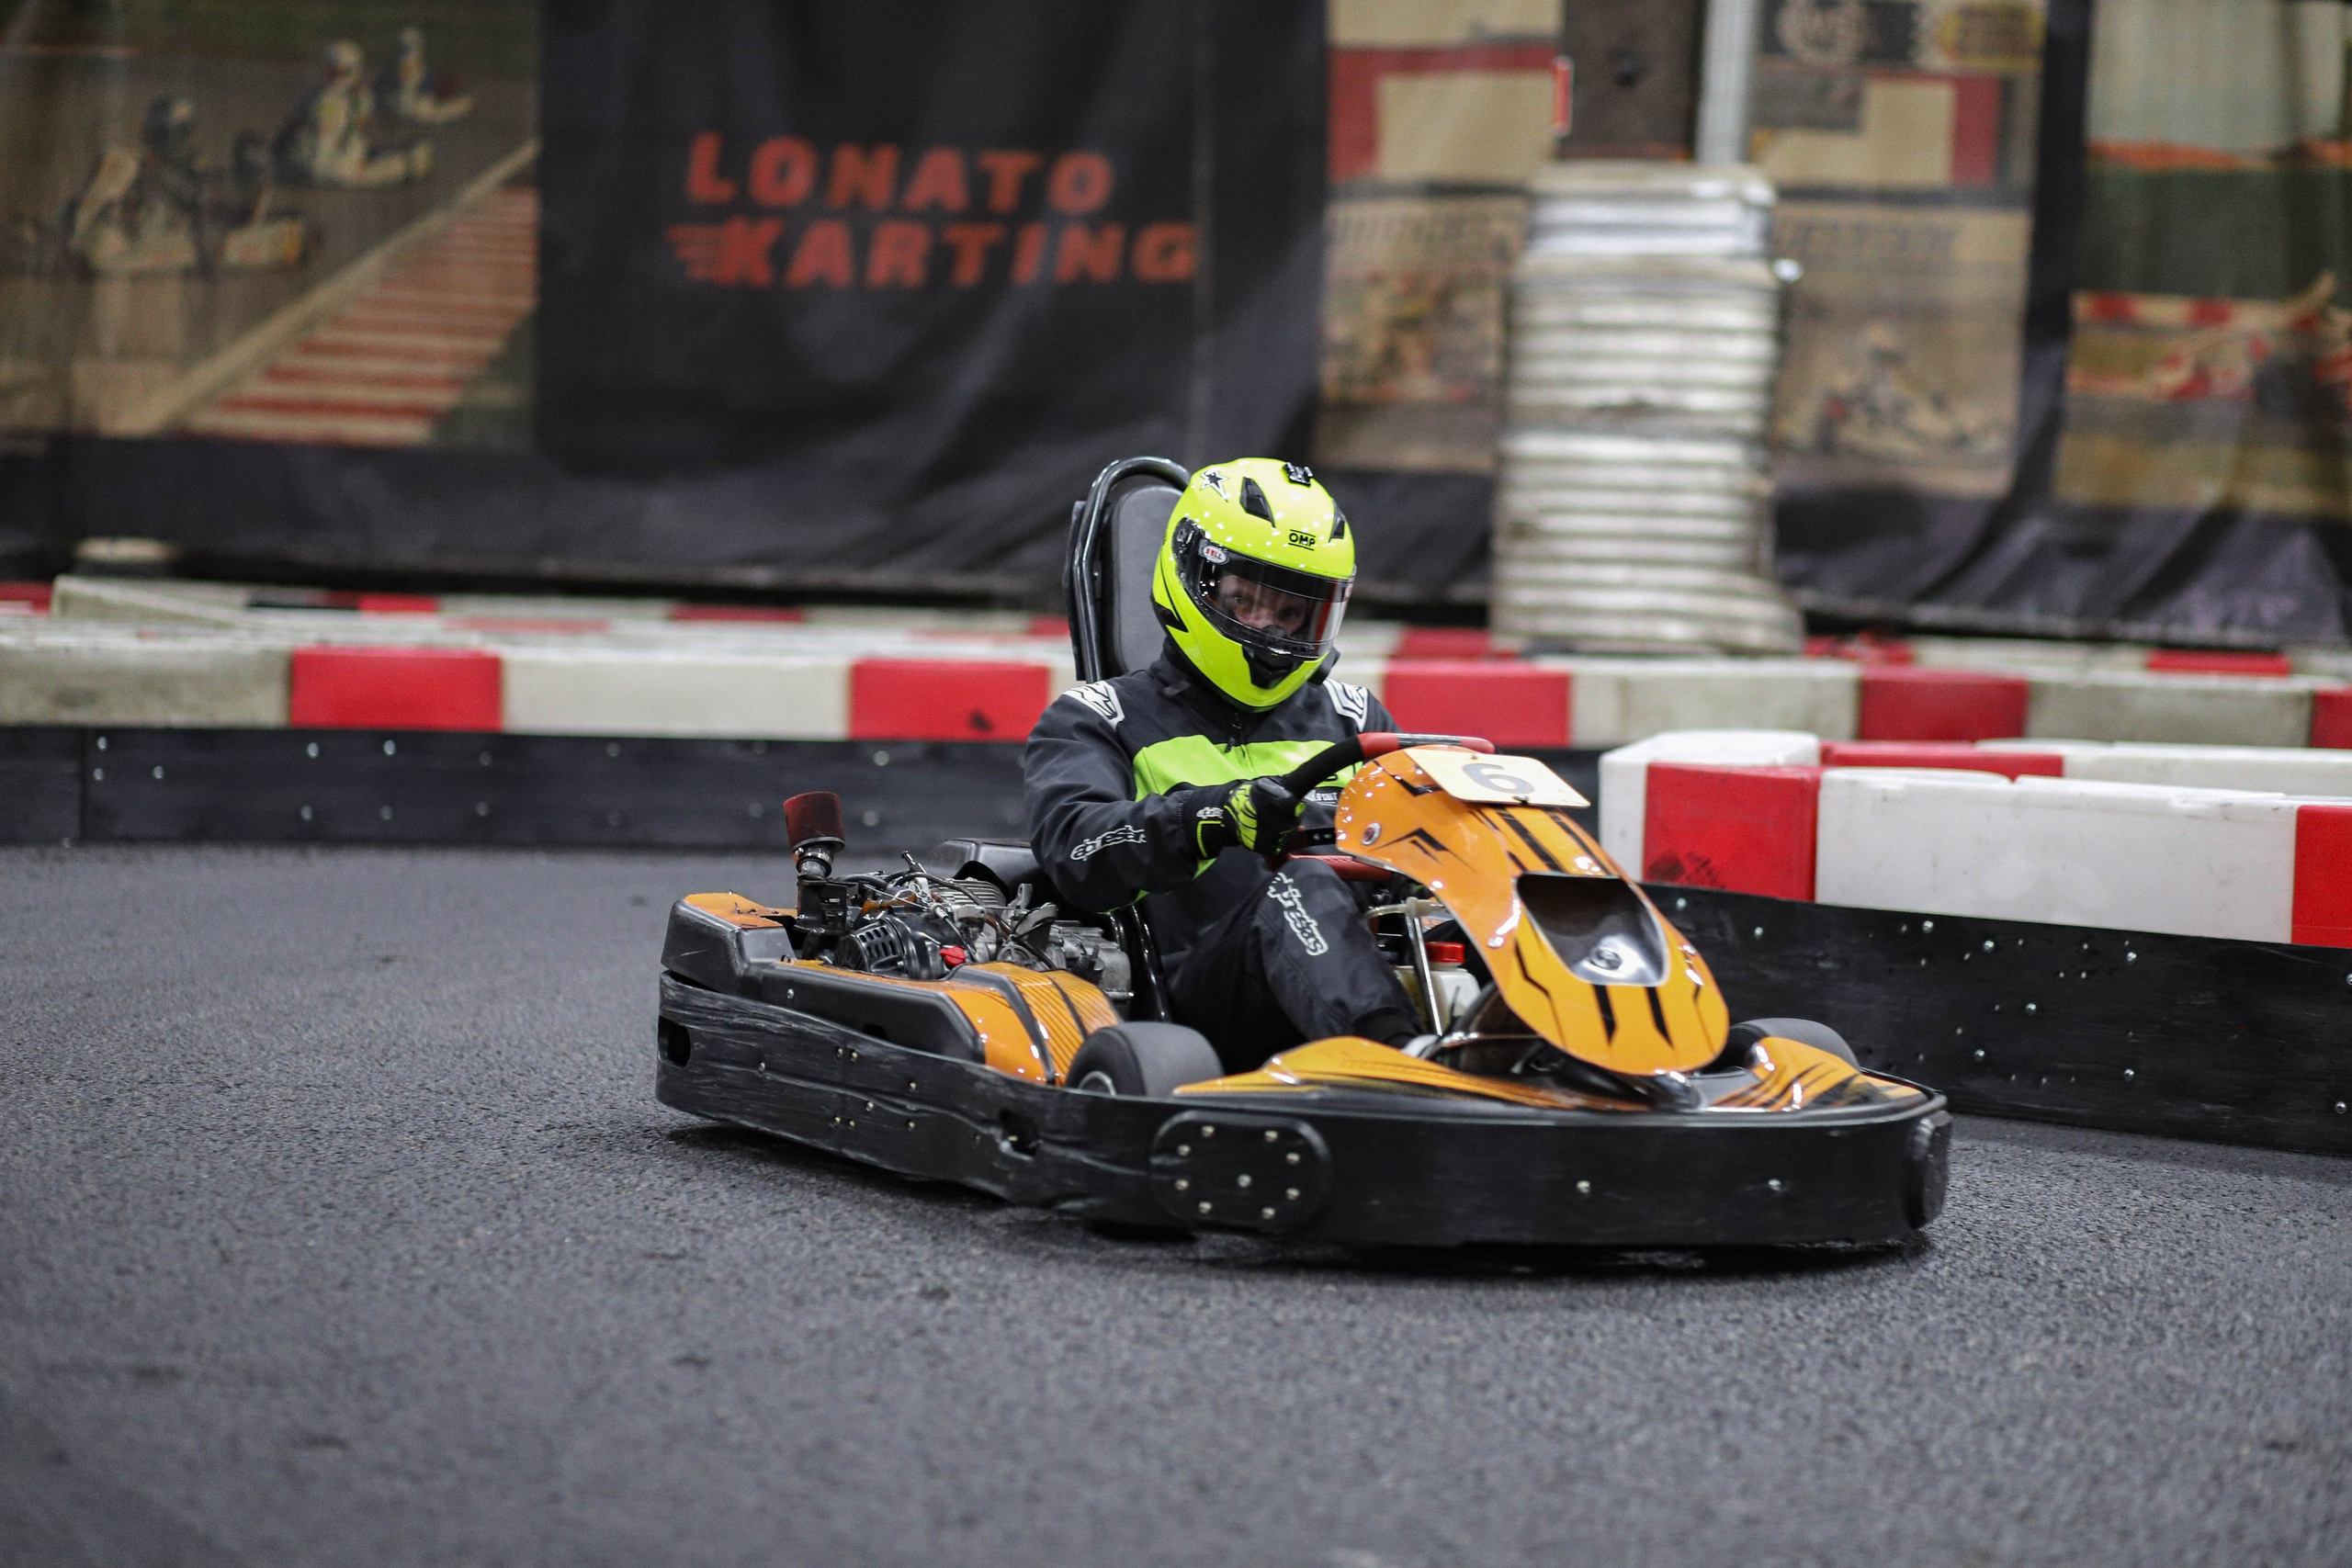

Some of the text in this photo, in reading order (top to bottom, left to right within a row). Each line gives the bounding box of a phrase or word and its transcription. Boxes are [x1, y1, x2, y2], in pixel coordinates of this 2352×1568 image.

[685, 130, 1114, 215] LONATO
[706, 215, 1199, 288] KARTING
[1205, 547, 1222, 560] BELL
[1289, 533, 1317, 547] OMP
[1462, 762, 1535, 794] 6
